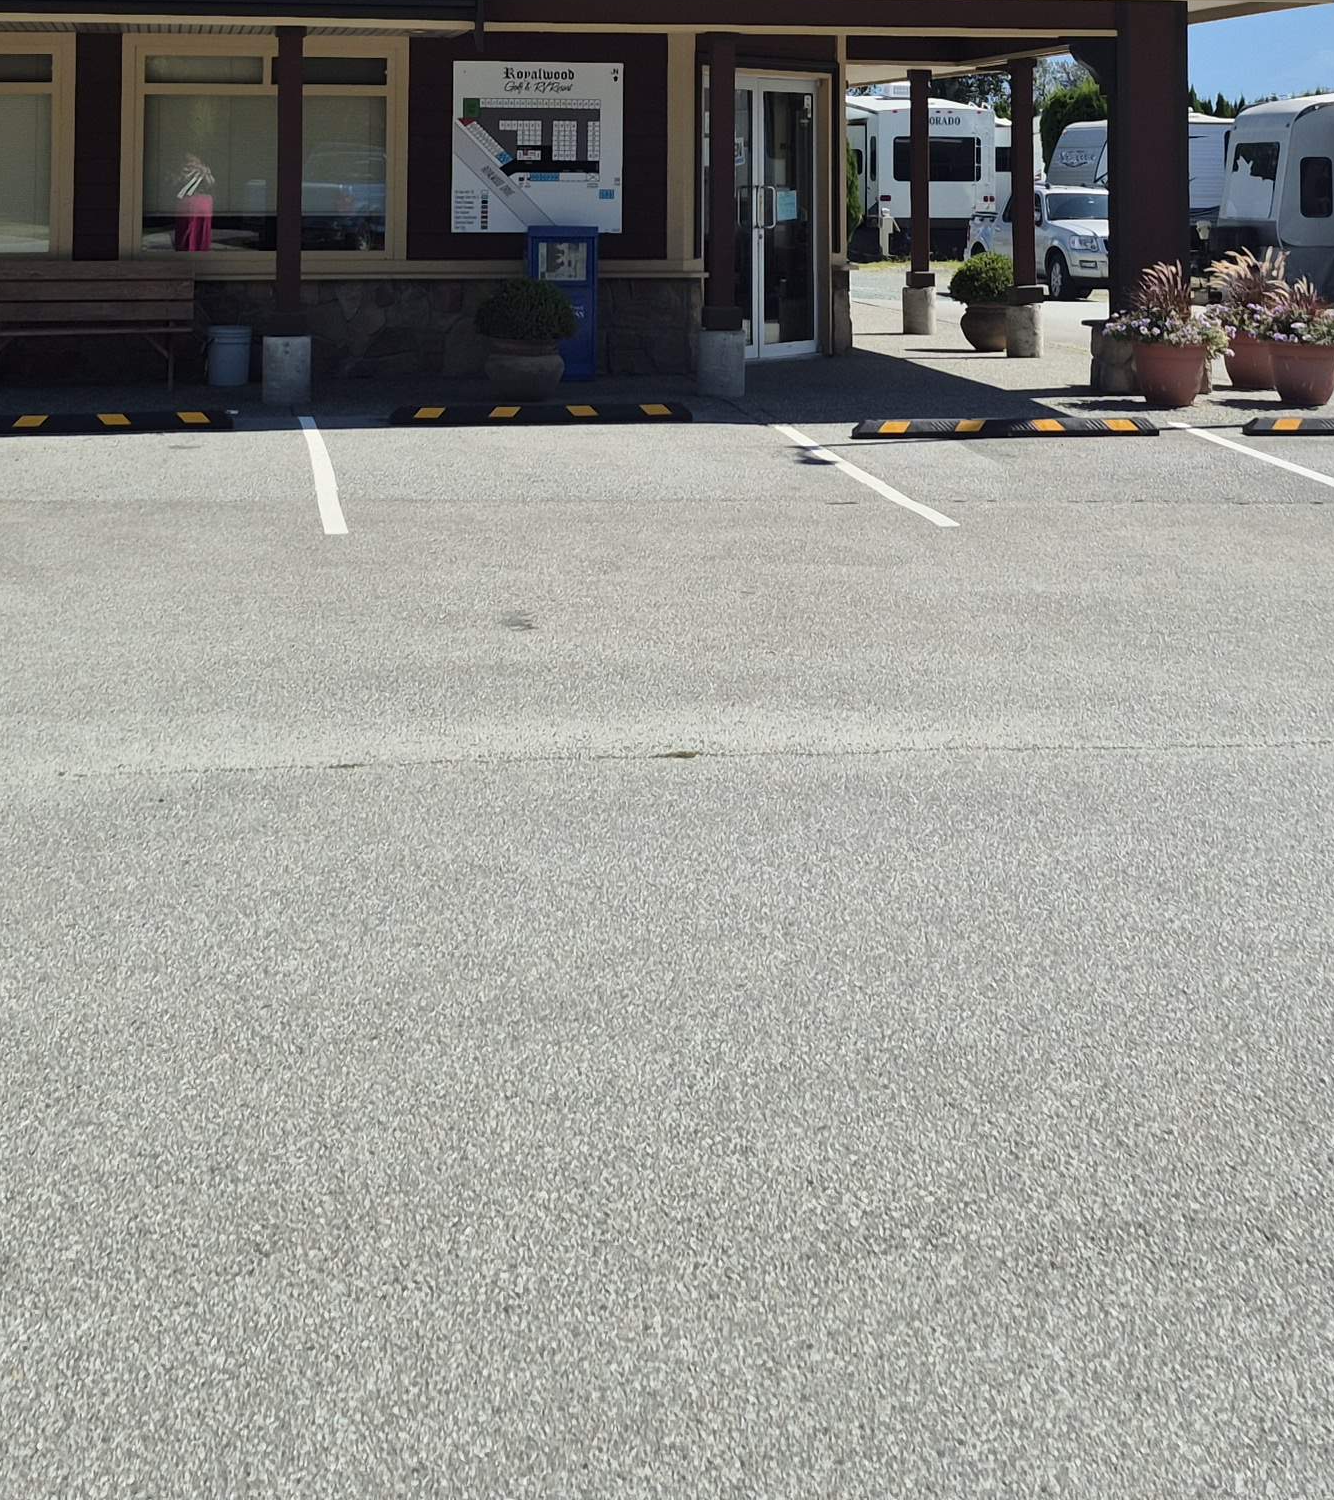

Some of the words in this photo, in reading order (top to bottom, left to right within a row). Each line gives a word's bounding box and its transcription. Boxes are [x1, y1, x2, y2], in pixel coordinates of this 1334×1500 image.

[503, 67, 575, 80] Royalwood
[504, 81, 524, 94] Golf
[929, 116, 961, 126] ORADO
